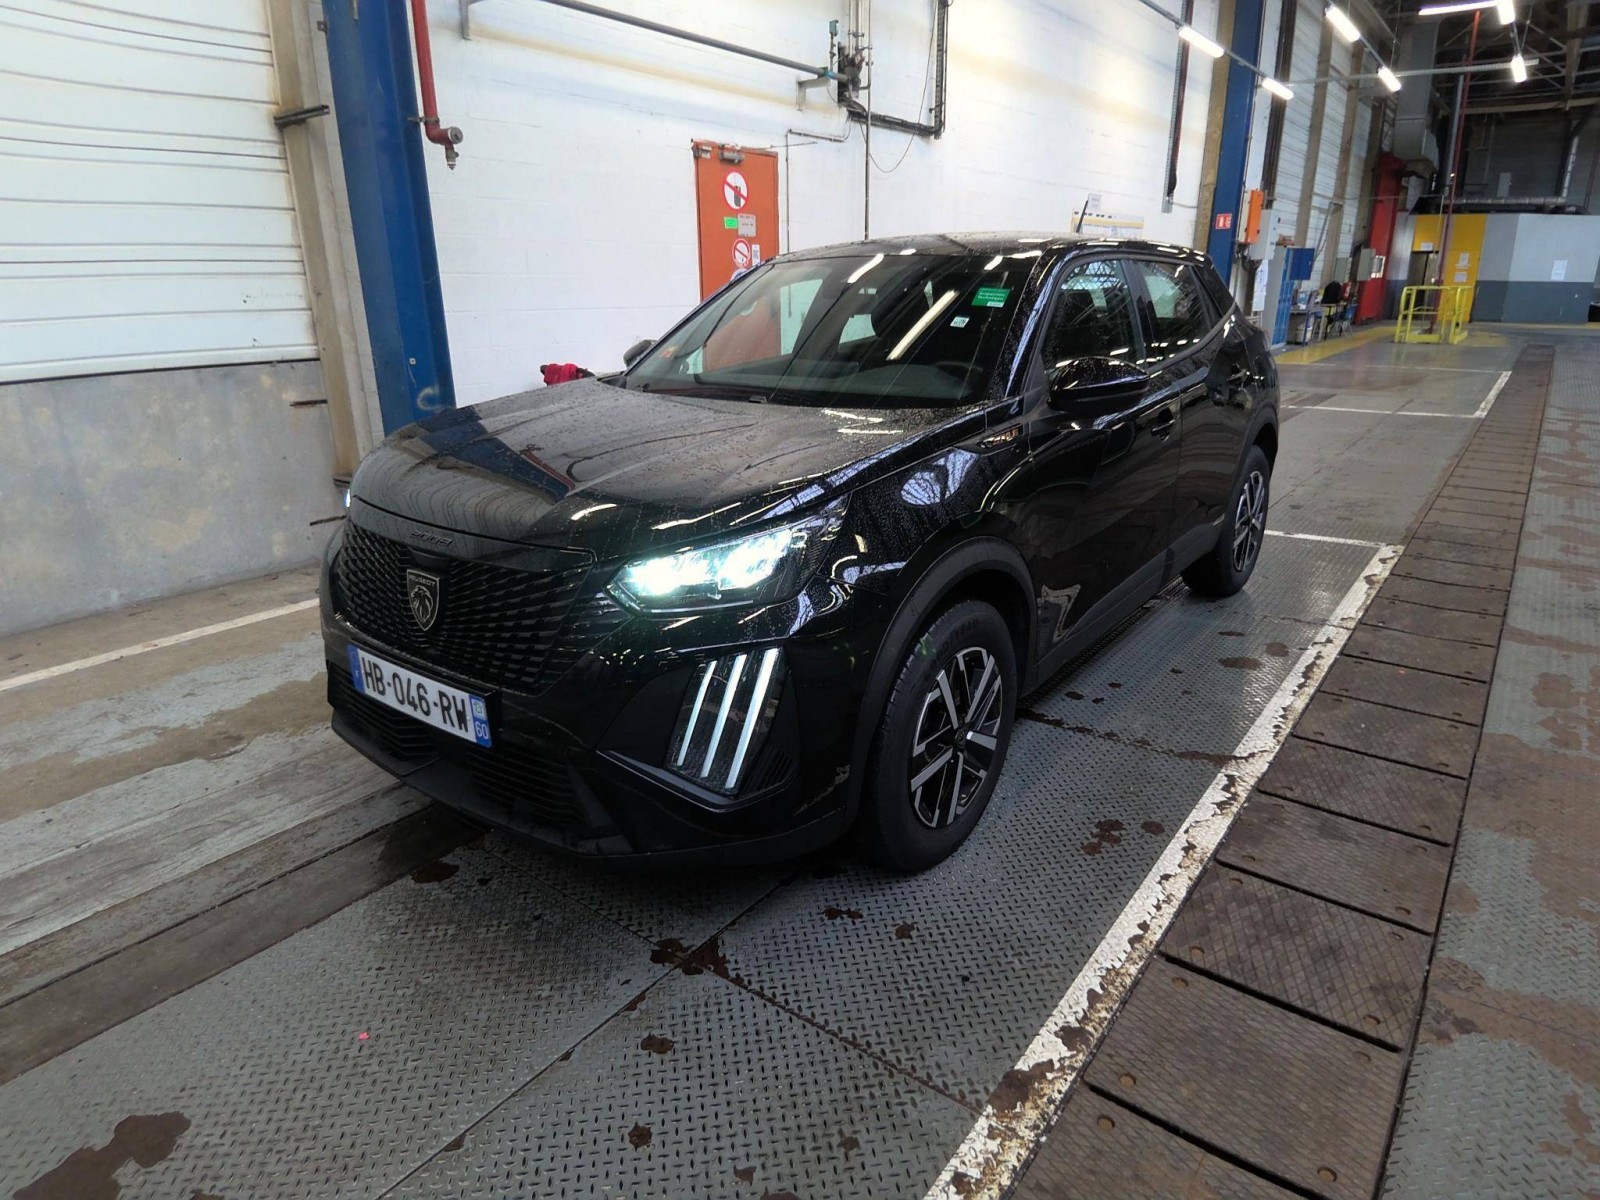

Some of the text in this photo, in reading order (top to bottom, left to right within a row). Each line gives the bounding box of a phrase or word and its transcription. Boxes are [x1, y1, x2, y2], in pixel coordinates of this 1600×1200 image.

[410, 530, 453, 546] 2008
[361, 657, 469, 733] HB-046-RW
[474, 721, 489, 740] 60
